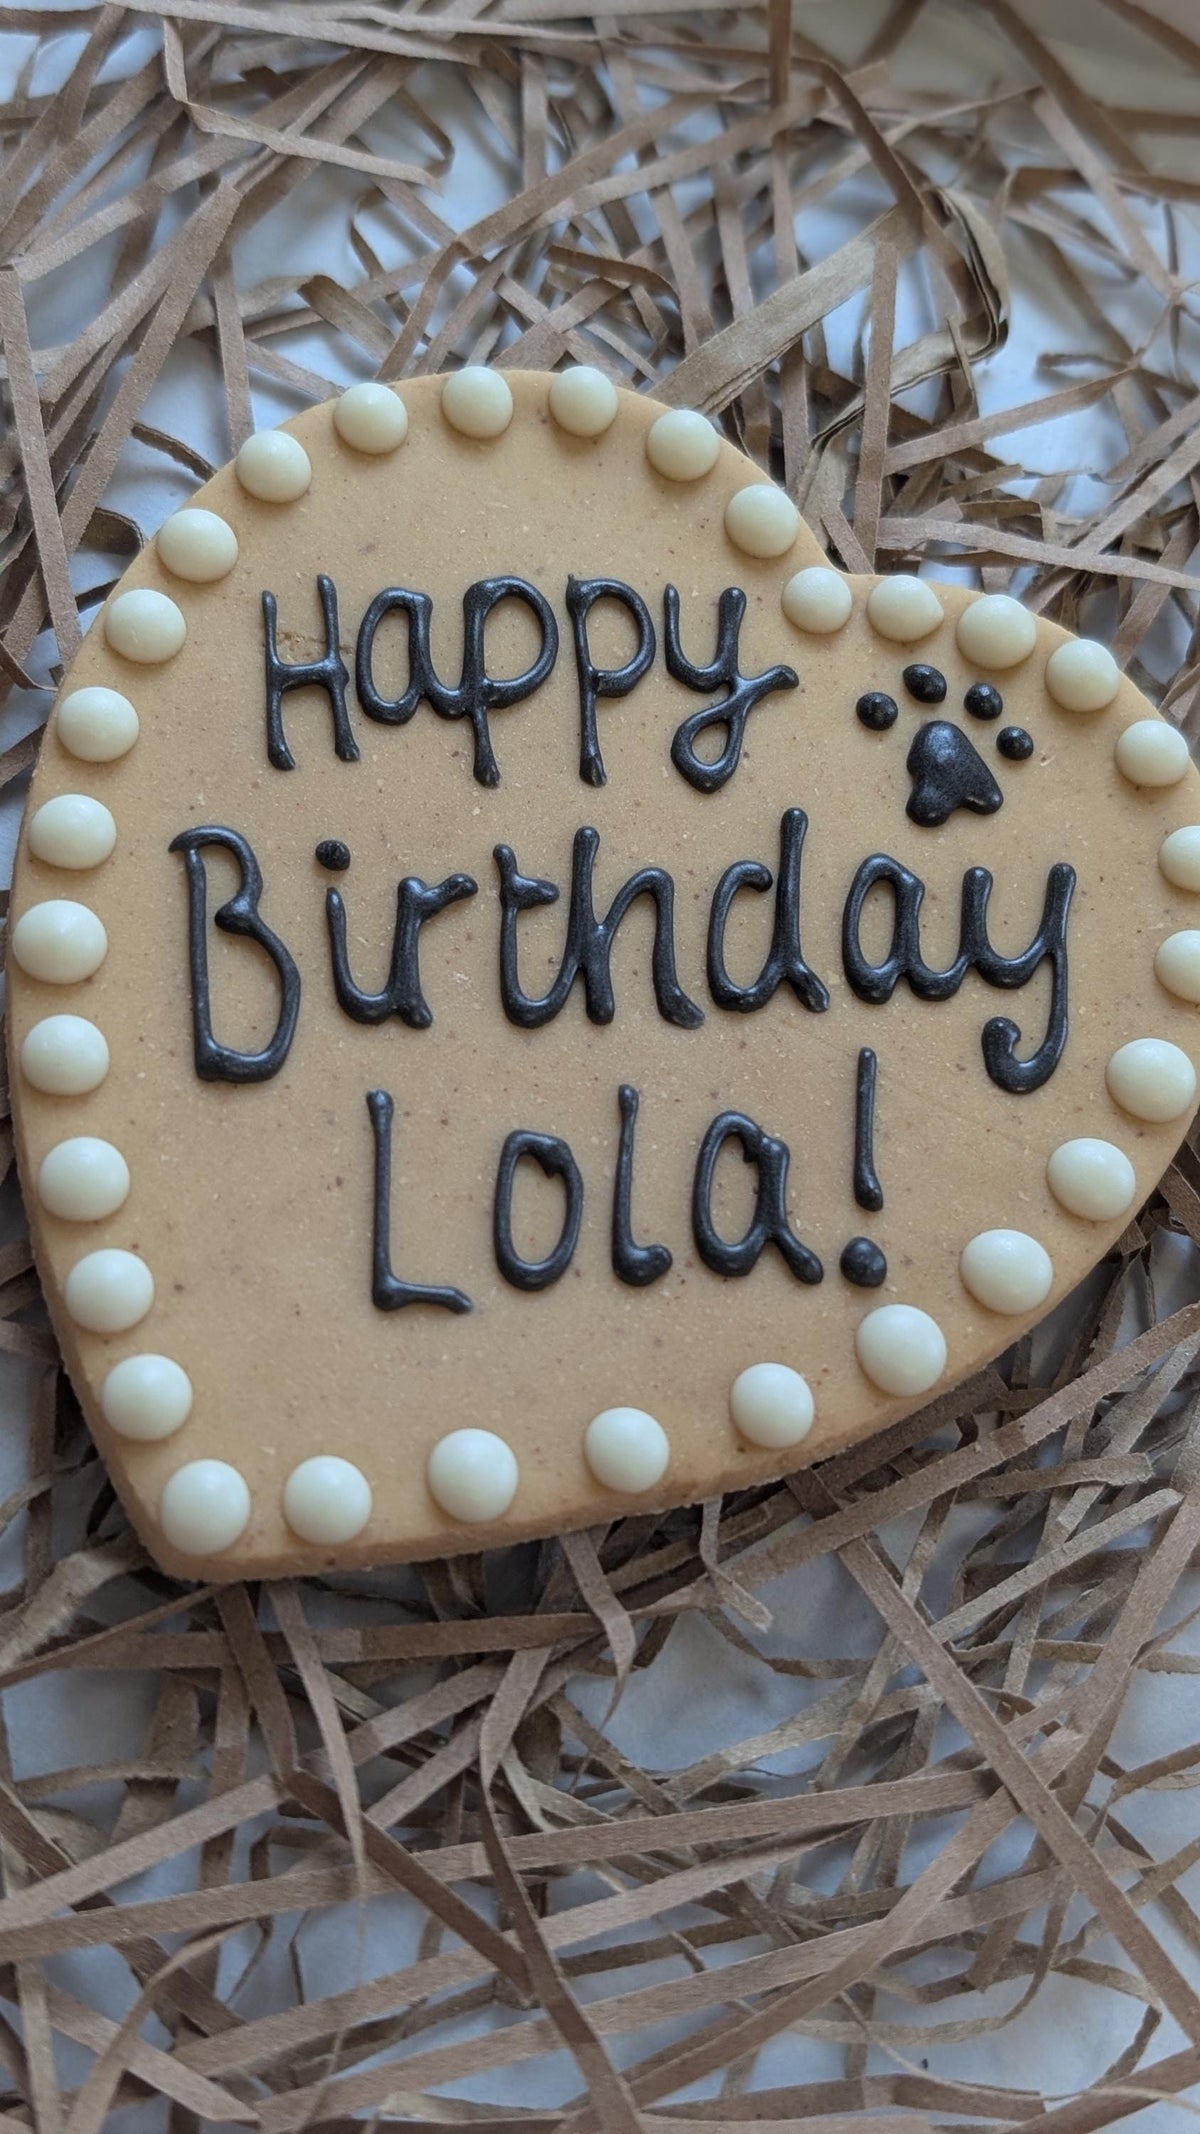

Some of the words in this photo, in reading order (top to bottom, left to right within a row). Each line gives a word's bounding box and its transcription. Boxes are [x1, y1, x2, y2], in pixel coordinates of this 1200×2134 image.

[261, 573, 800, 796] Happy
[168, 807, 1077, 1097] Birthday
[366, 1047, 888, 1315] Lola!
